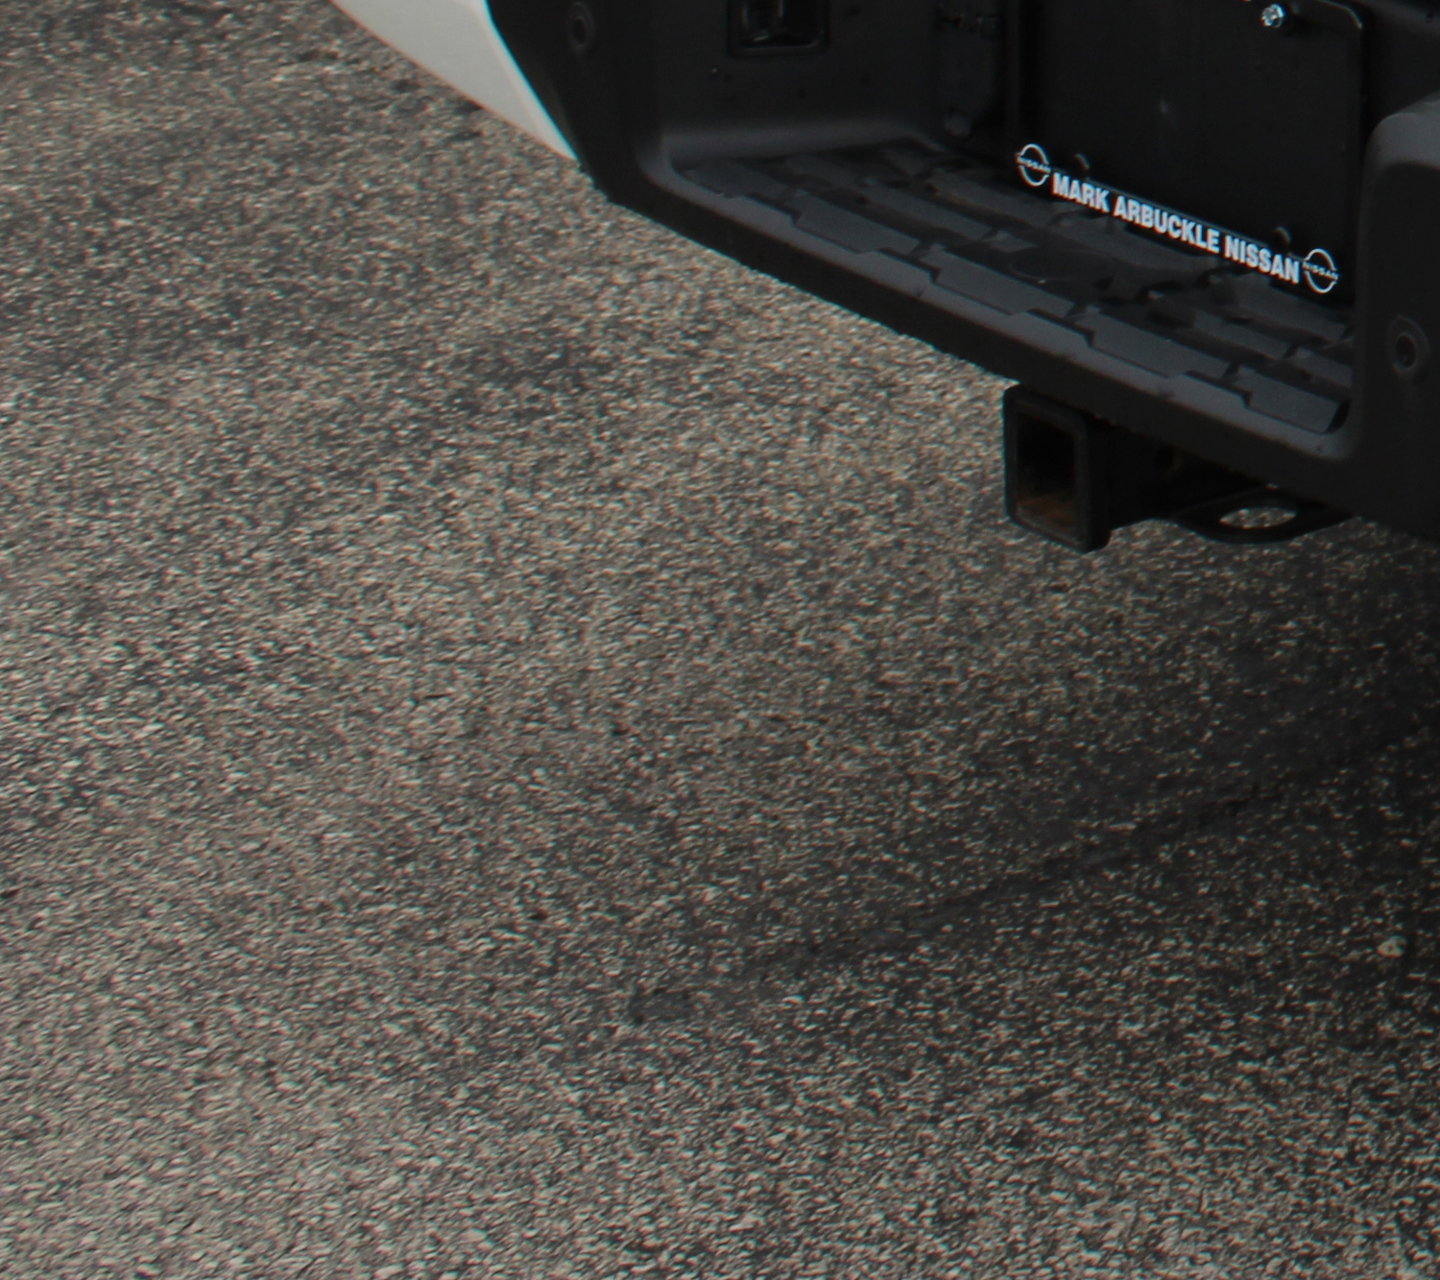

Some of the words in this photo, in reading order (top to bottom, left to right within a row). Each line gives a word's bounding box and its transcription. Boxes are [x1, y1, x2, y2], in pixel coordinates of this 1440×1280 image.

[1052, 172, 1110, 213] MARK
[1113, 195, 1220, 254] ARBUCKLE
[1224, 235, 1300, 285] NISSAN
